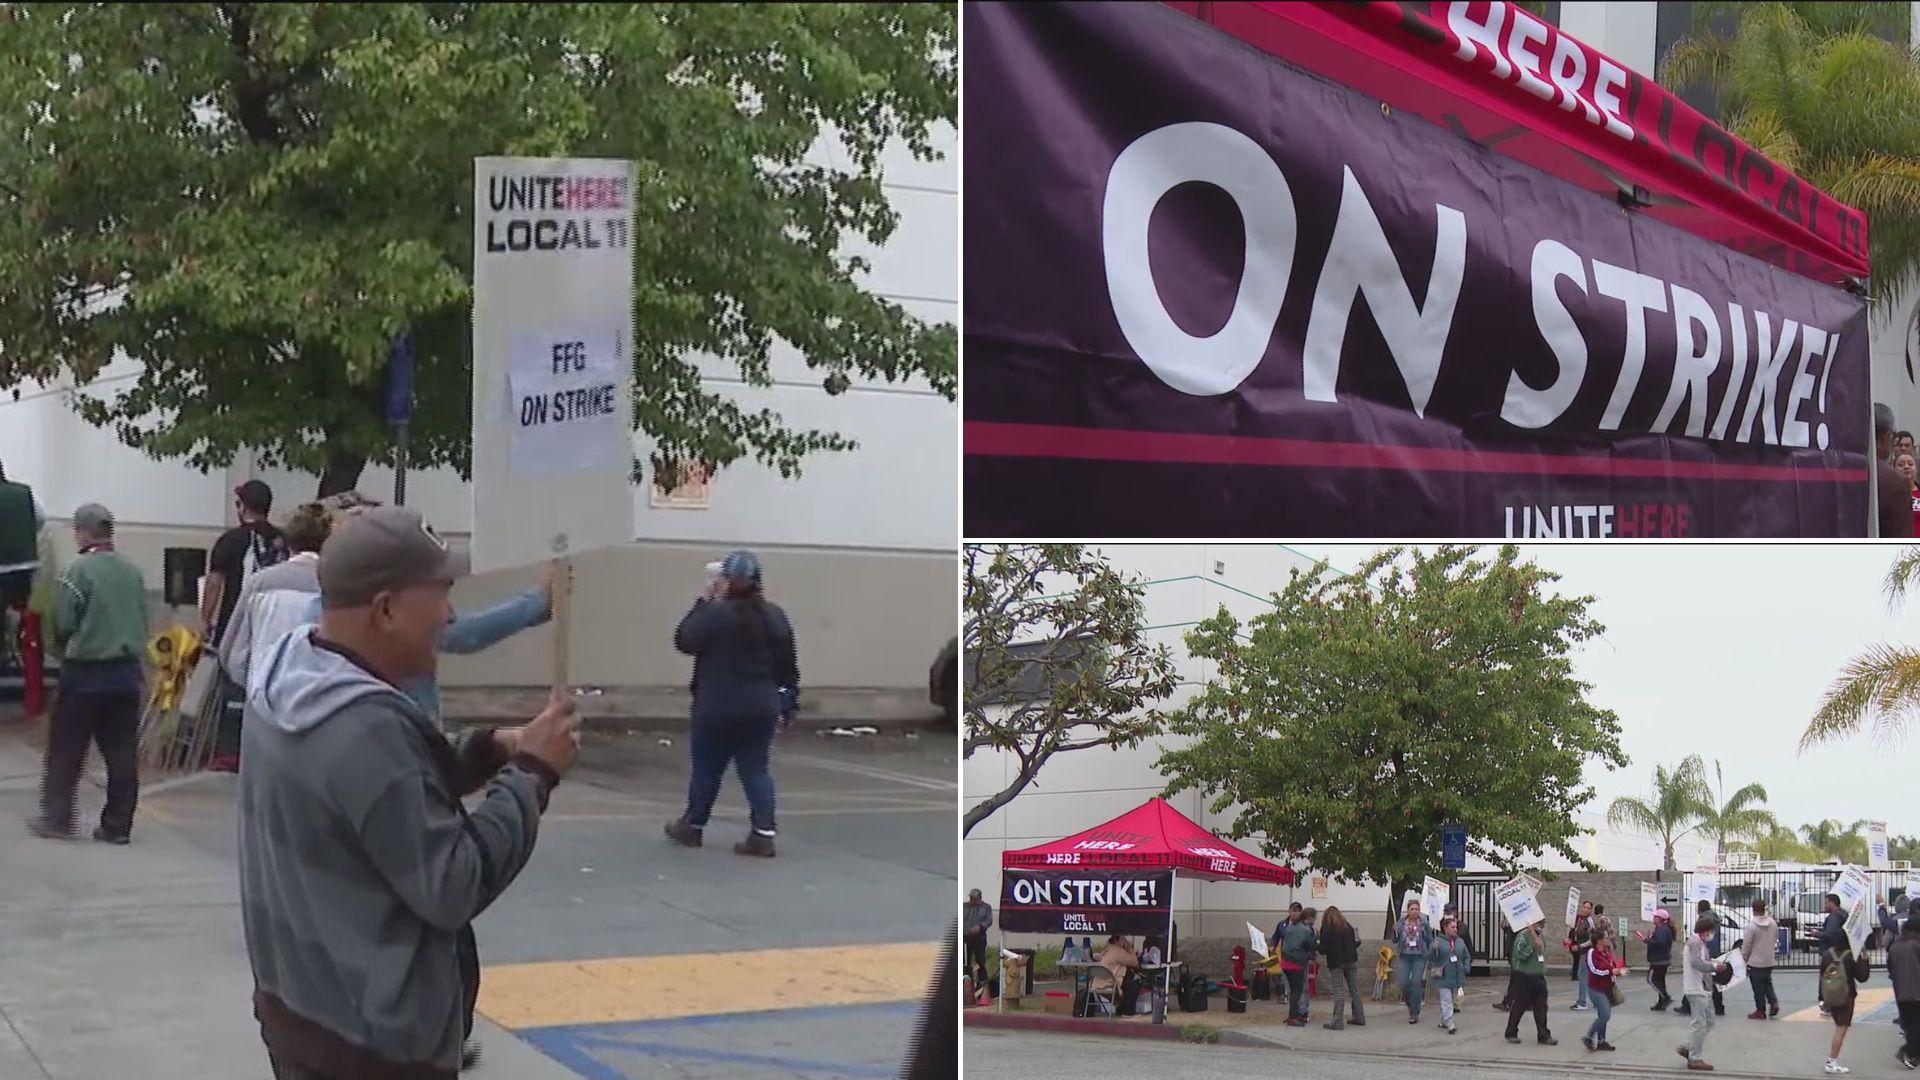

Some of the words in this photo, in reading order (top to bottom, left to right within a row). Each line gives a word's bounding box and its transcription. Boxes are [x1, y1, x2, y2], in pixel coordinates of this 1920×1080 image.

[487, 219, 601, 252] LOCAL
[605, 219, 627, 248] 11
[1837, 208, 1861, 258] 11
[1102, 121, 1466, 419] ON
[1500, 239, 1840, 452] STRIKE!
[551, 341, 586, 375] FFG
[521, 394, 548, 426] ON
[552, 383, 616, 421] STRIKE
[1088, 853, 1147, 864] LOCAL
[1150, 853, 1169, 864] 11
[1013, 878, 1053, 905] ON
[1059, 879, 1157, 906] STRIKE!
[1063, 921, 1094, 931] LOCAL
[1096, 922, 1107, 932] 11
